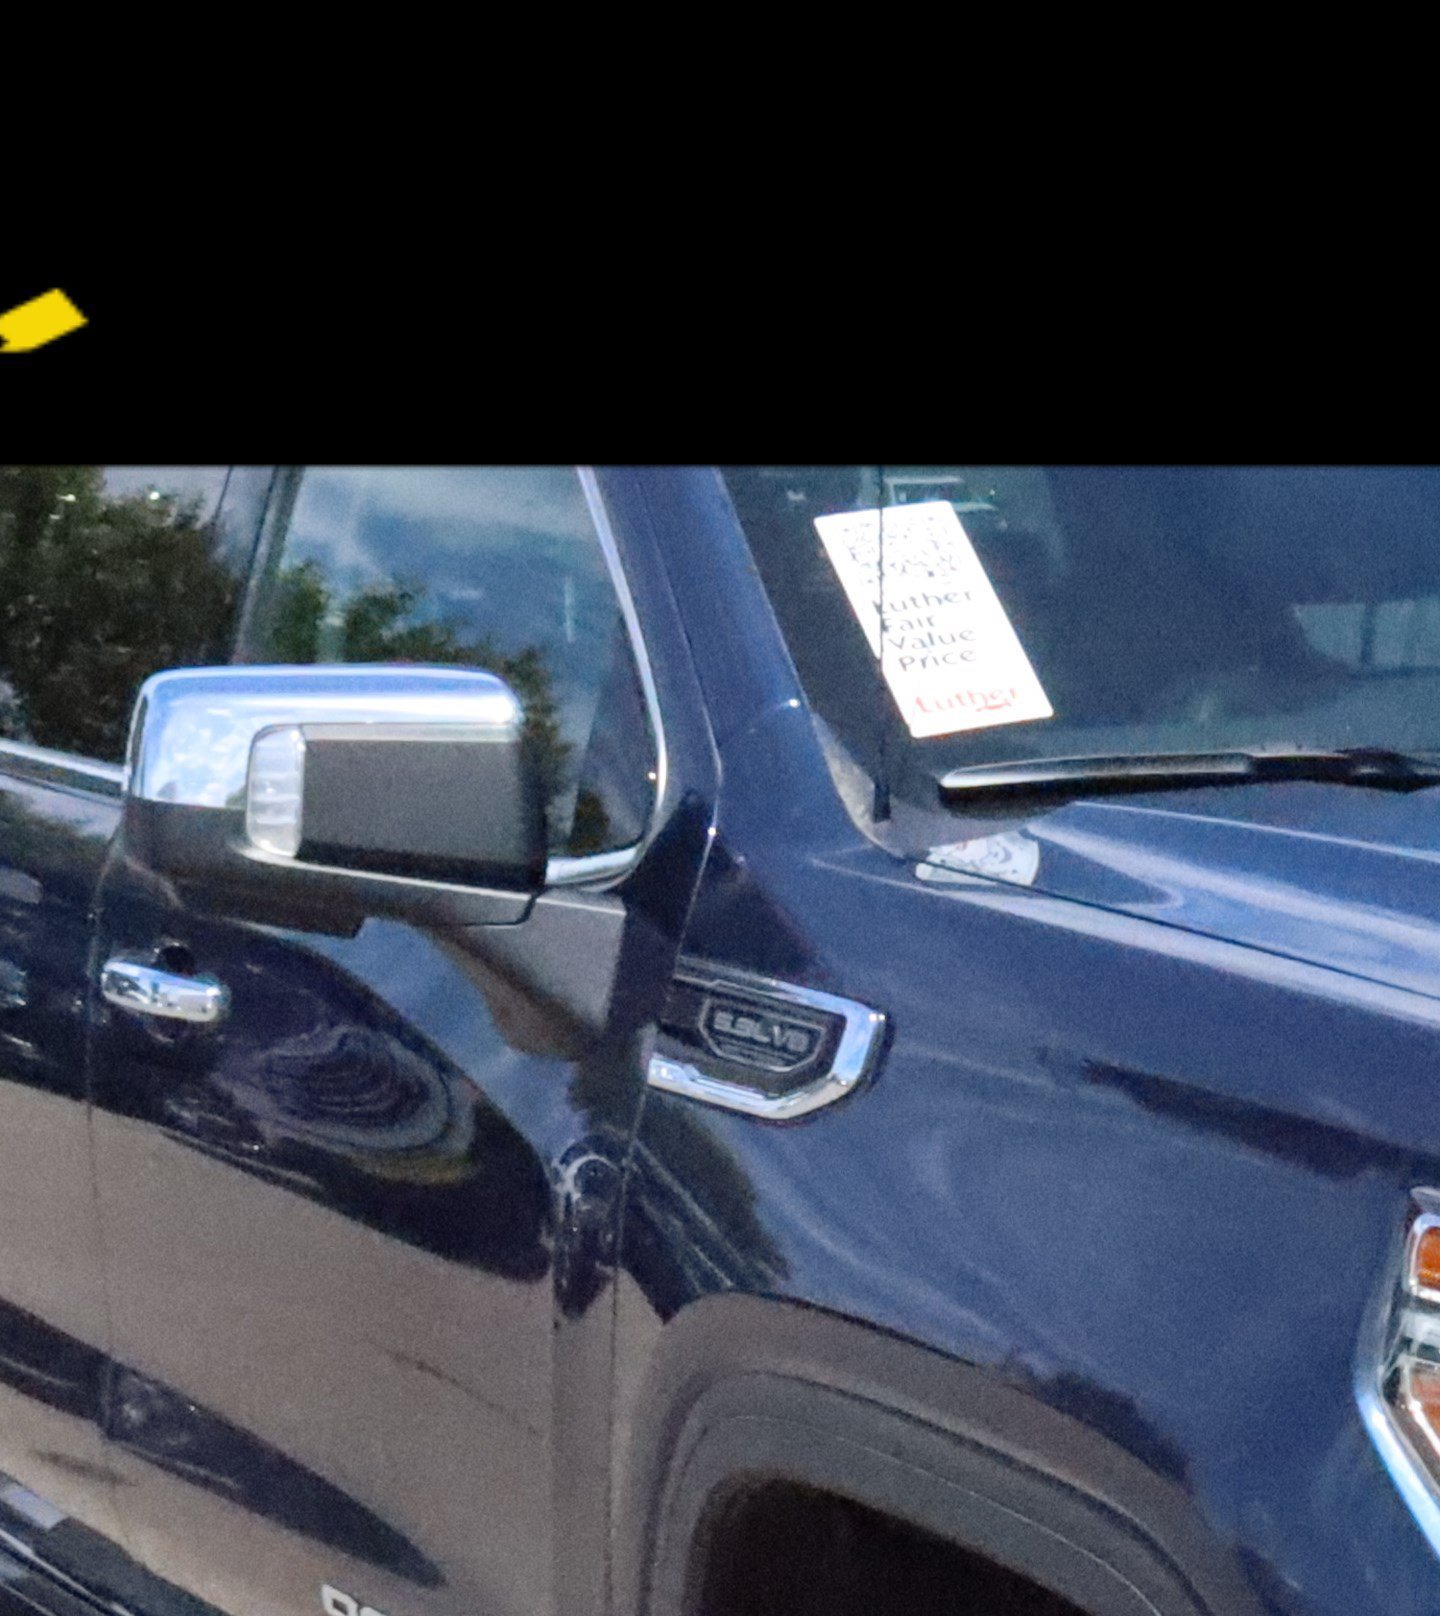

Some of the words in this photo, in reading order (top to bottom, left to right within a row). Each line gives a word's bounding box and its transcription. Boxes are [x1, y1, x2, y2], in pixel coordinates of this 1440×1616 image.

[871, 590, 972, 615] Luther
[886, 628, 976, 651] Value
[897, 648, 977, 672] Price
